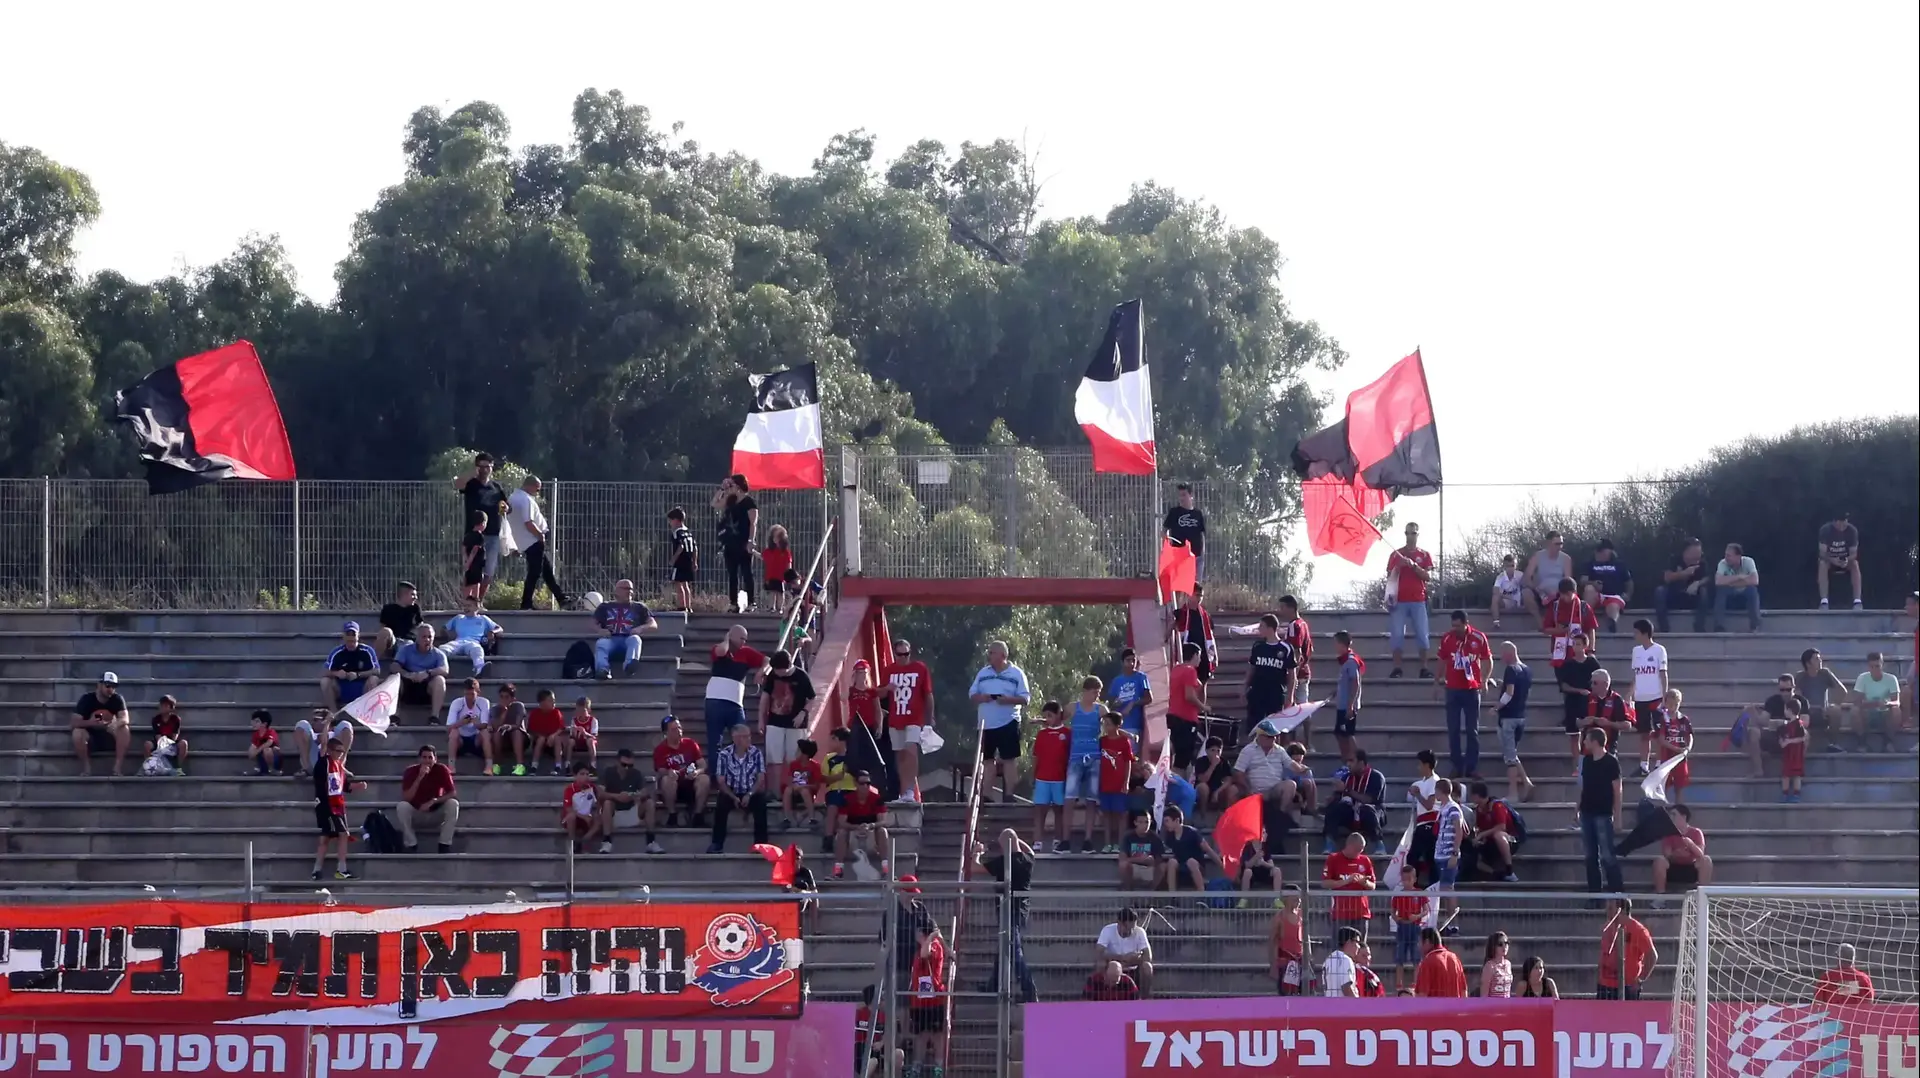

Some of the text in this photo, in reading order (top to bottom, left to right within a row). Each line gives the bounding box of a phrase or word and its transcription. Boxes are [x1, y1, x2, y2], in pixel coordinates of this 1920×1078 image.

[890, 672, 919, 687] JUST
[893, 687, 912, 701] DO
[896, 700, 912, 715] IT.
[204, 928, 379, 998] תמיד
[399, 928, 521, 1020] כאן
[541, 926, 687, 999] והיה
[87, 1032, 287, 1073] הספורט
[311, 1025, 438, 1078] למען
[622, 1028, 776, 1075] טוטו
[1134, 1019, 1676, 1078] למען הספורט בישראל
